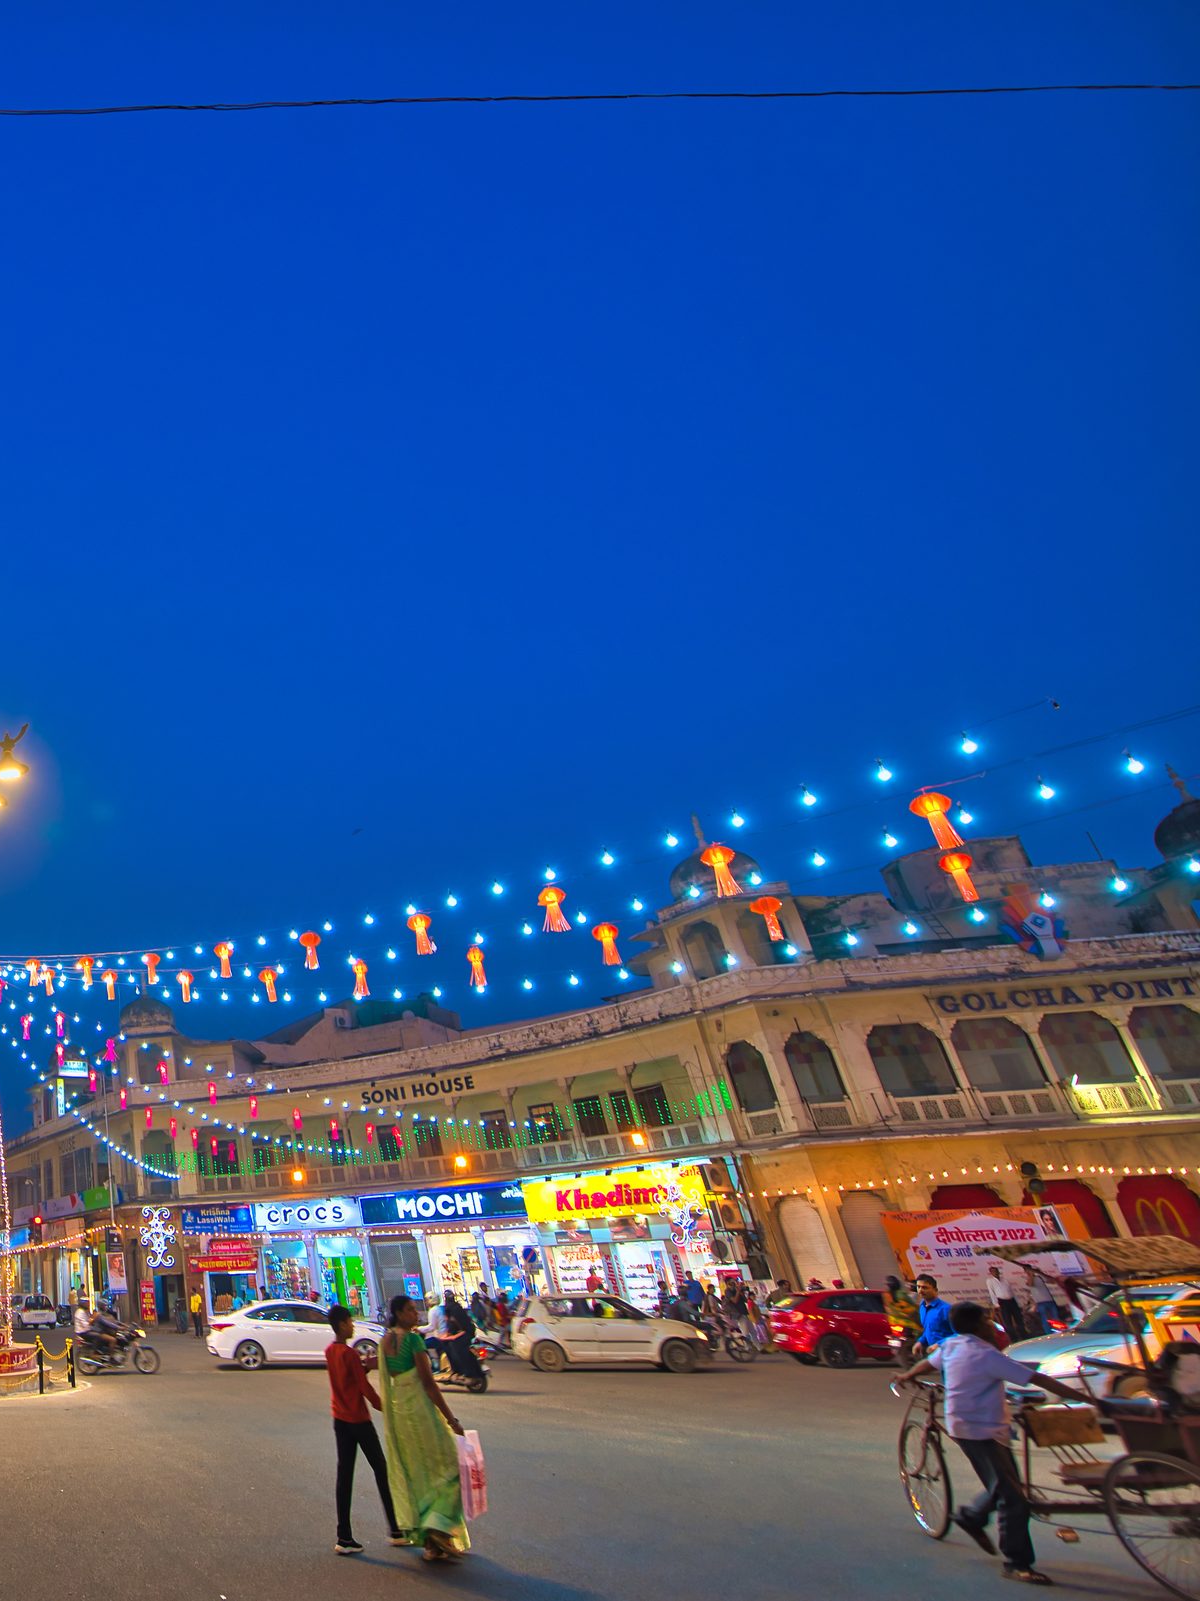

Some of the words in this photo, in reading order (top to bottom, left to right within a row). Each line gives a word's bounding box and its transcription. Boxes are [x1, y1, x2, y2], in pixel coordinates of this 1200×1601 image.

[937, 985, 1085, 1014] GOLCHA
[1088, 975, 1196, 1002] POINT
[361, 1086, 406, 1105] SONI
[411, 1075, 475, 1098] HOUSE
[200, 1208, 230, 1217] Krishna
[267, 1202, 345, 1224] crocs
[396, 1191, 484, 1220] MOCHI
[933, 1226, 997, 1245] दीपोत्सव
[998, 1228, 1036, 1241] 2022
